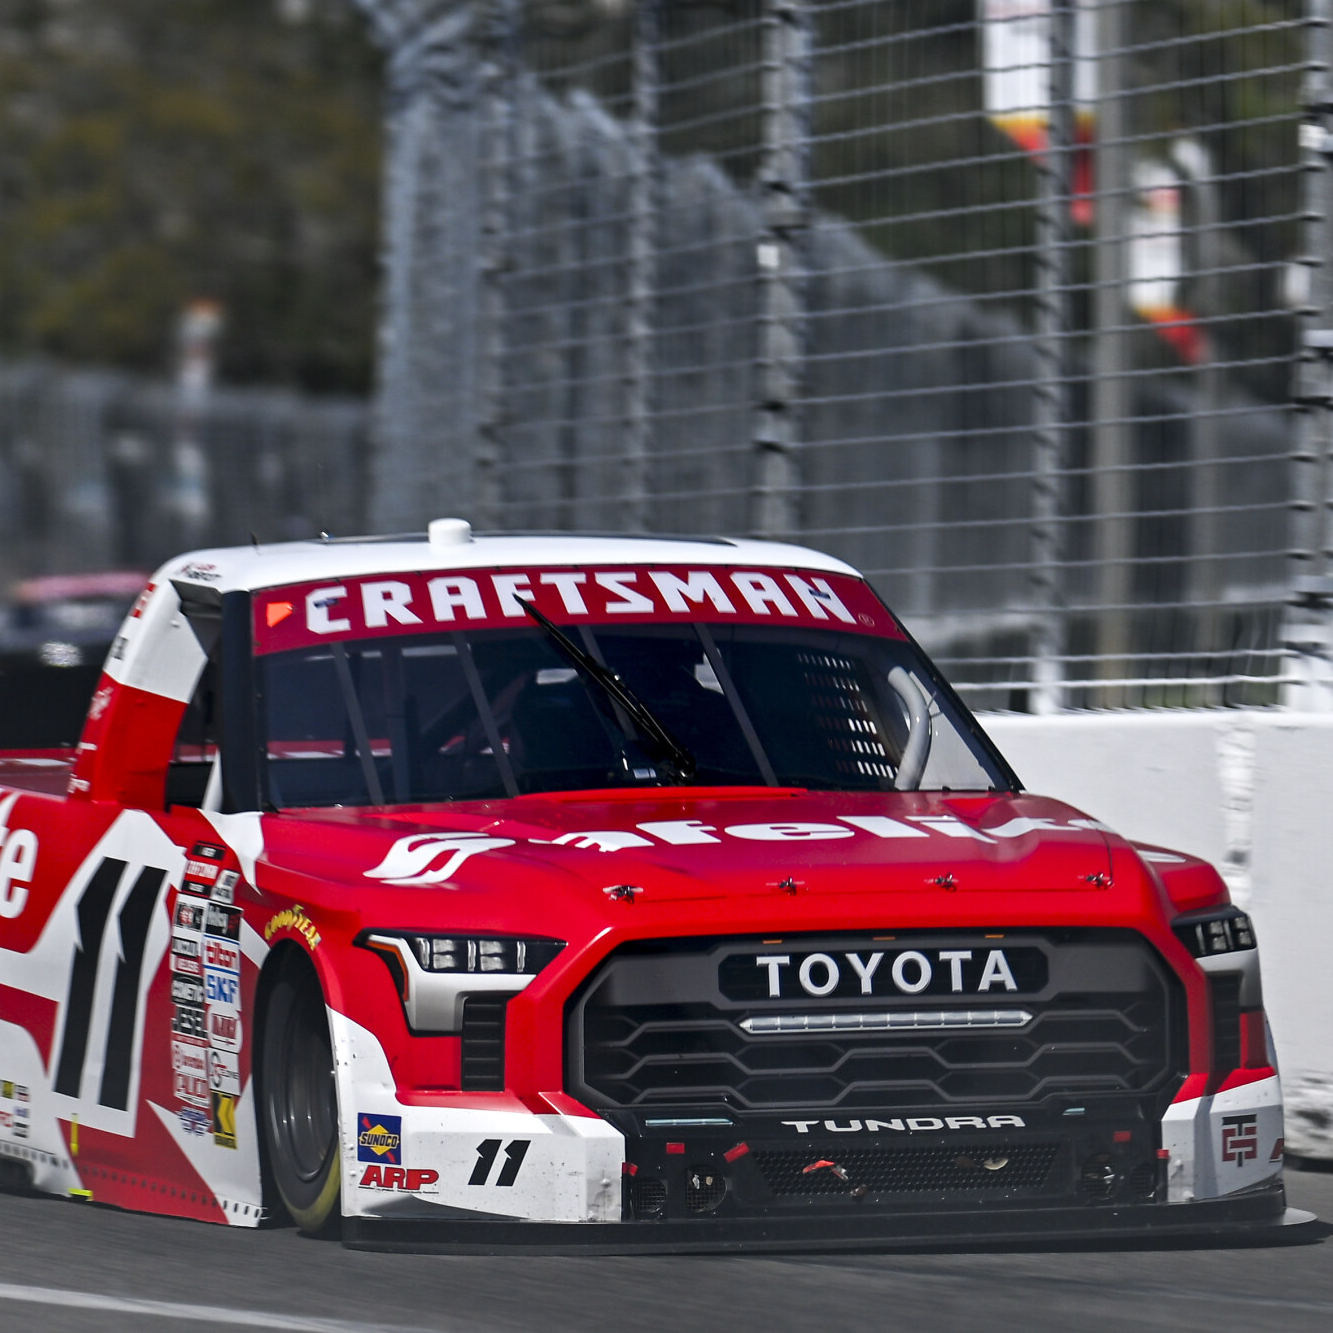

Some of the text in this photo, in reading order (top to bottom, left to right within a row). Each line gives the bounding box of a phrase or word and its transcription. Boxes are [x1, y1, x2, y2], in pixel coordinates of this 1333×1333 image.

[306, 570, 857, 635] CRAFTSMAN
[52, 855, 169, 1112] 11
[205, 974, 238, 1004] SKF
[756, 949, 1018, 998] TOYOTA
[360, 1133, 399, 1148] SUNOCO
[781, 1115, 1026, 1133] TUNDRA
[359, 1164, 439, 1190] ARP
[468, 1138, 531, 1187] 11
